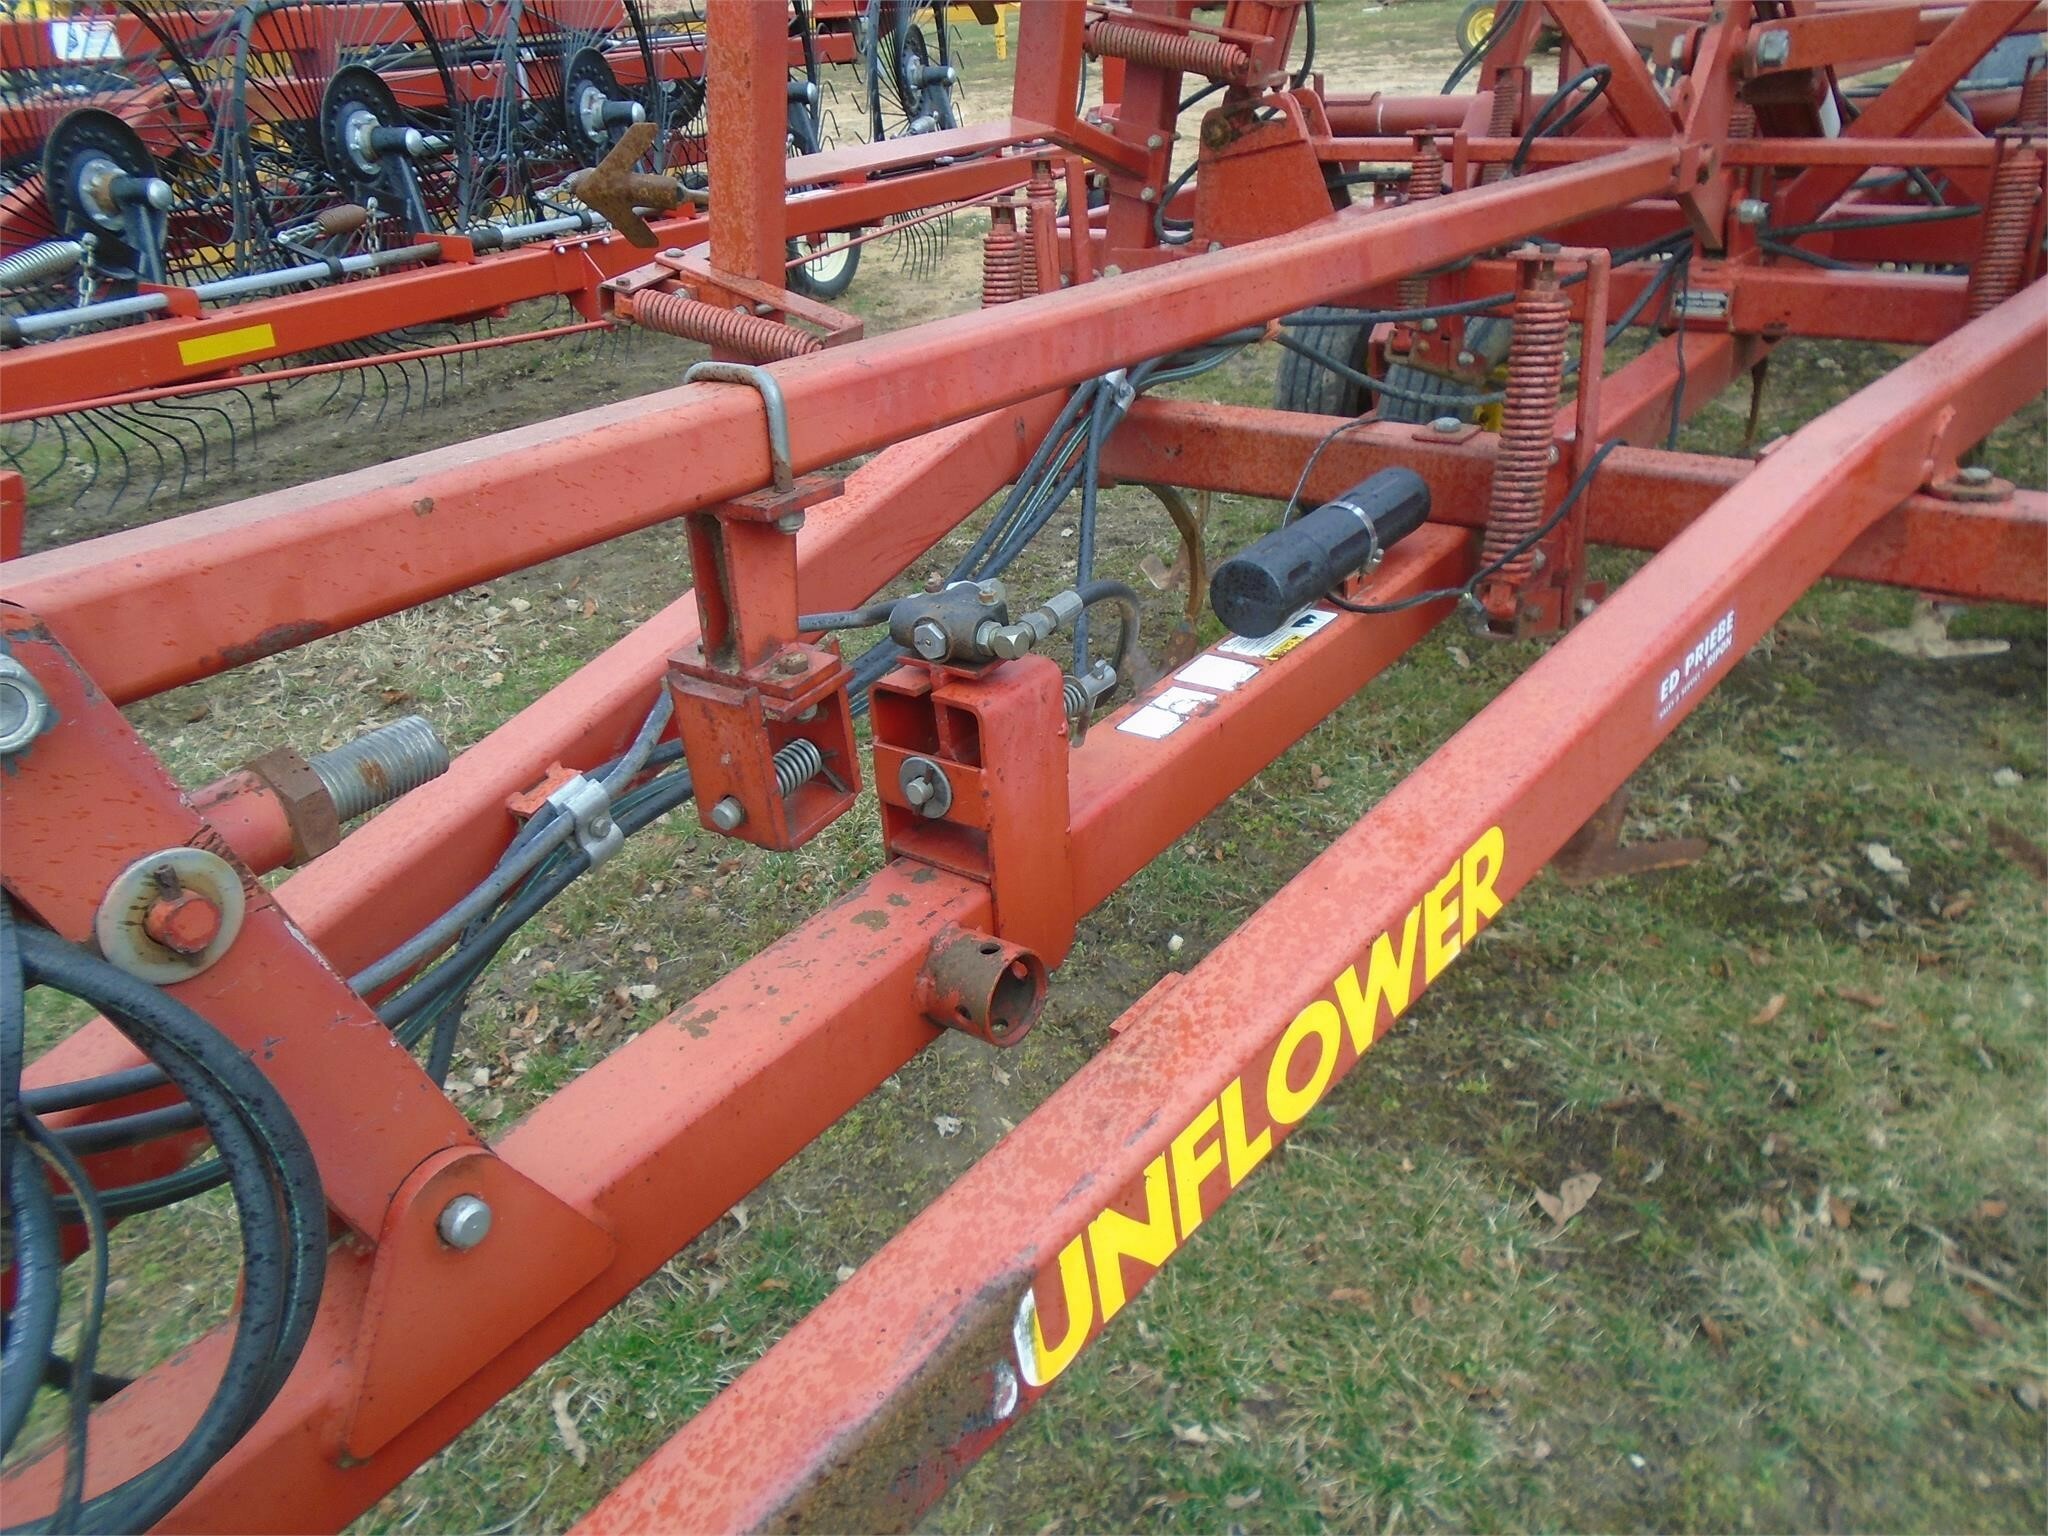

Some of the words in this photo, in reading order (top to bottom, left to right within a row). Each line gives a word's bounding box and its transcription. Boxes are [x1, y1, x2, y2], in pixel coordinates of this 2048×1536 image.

[1660, 668, 1680, 703] ED
[1684, 609, 1734, 677] PRIEBE
[995, 825, 1504, 1419] UNFLOWER
